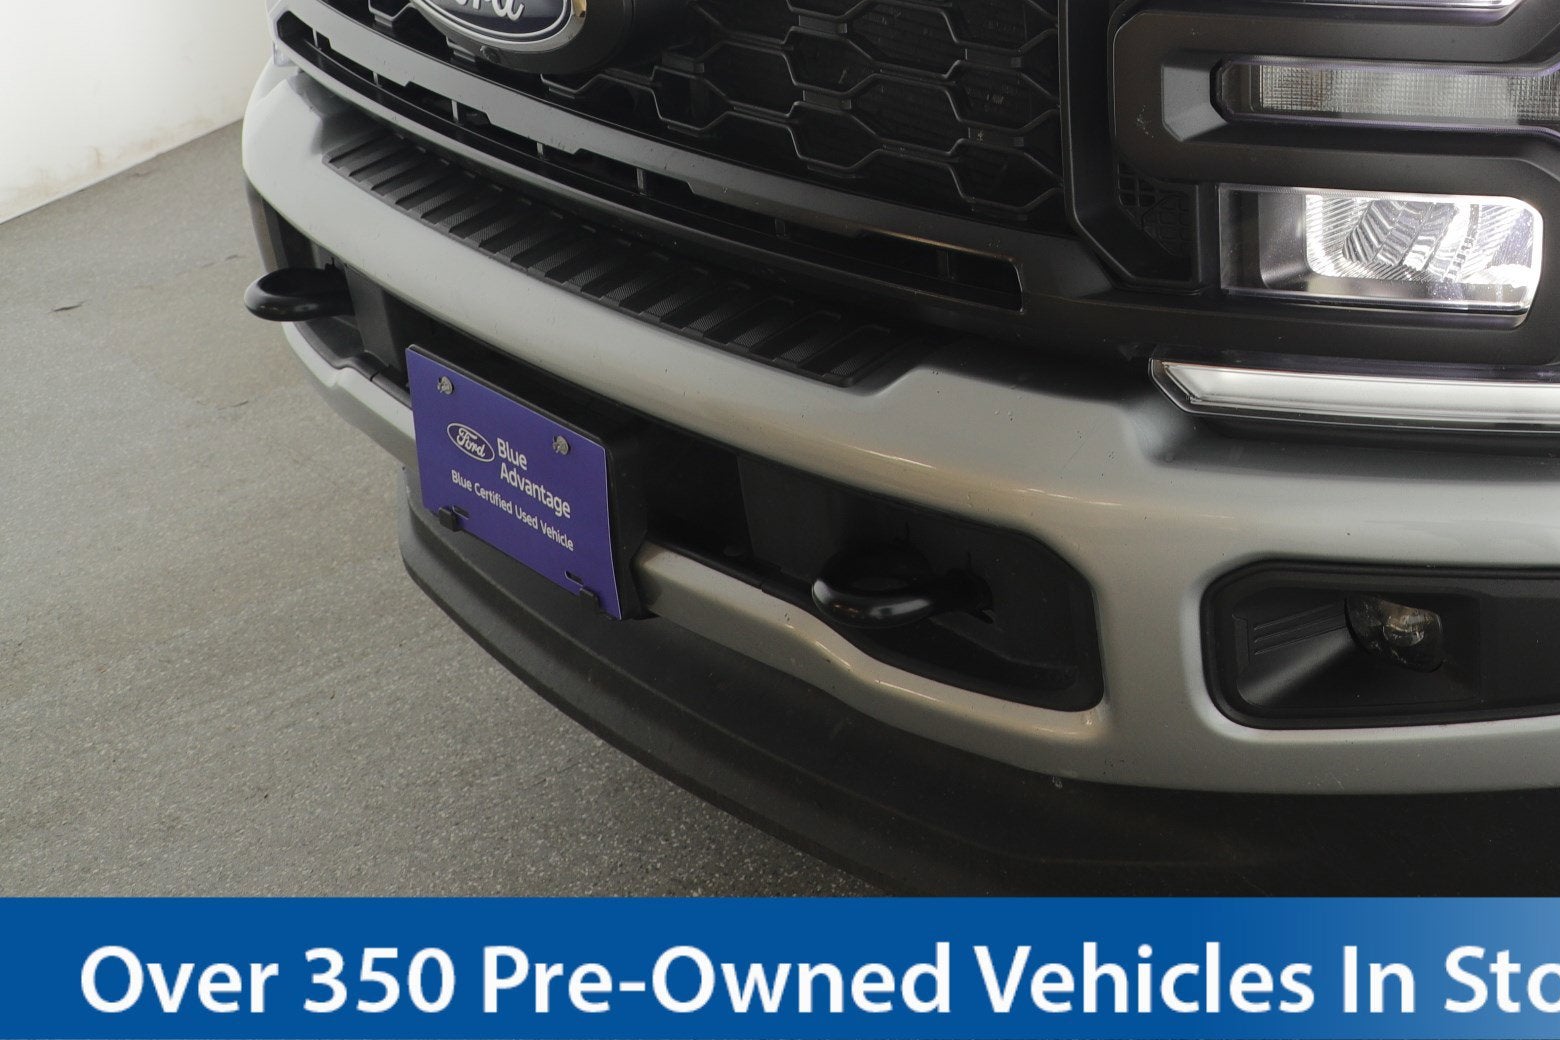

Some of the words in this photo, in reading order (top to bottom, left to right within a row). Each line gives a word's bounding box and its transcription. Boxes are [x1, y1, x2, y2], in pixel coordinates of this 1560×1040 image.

[456, 427, 486, 458] Ford
[496, 437, 528, 471] Blue
[451, 469, 473, 492] Blue
[474, 482, 513, 514] Certified
[515, 505, 539, 530] Used
[540, 518, 574, 552] Vehicle
[500, 462, 571, 519] Advantage
